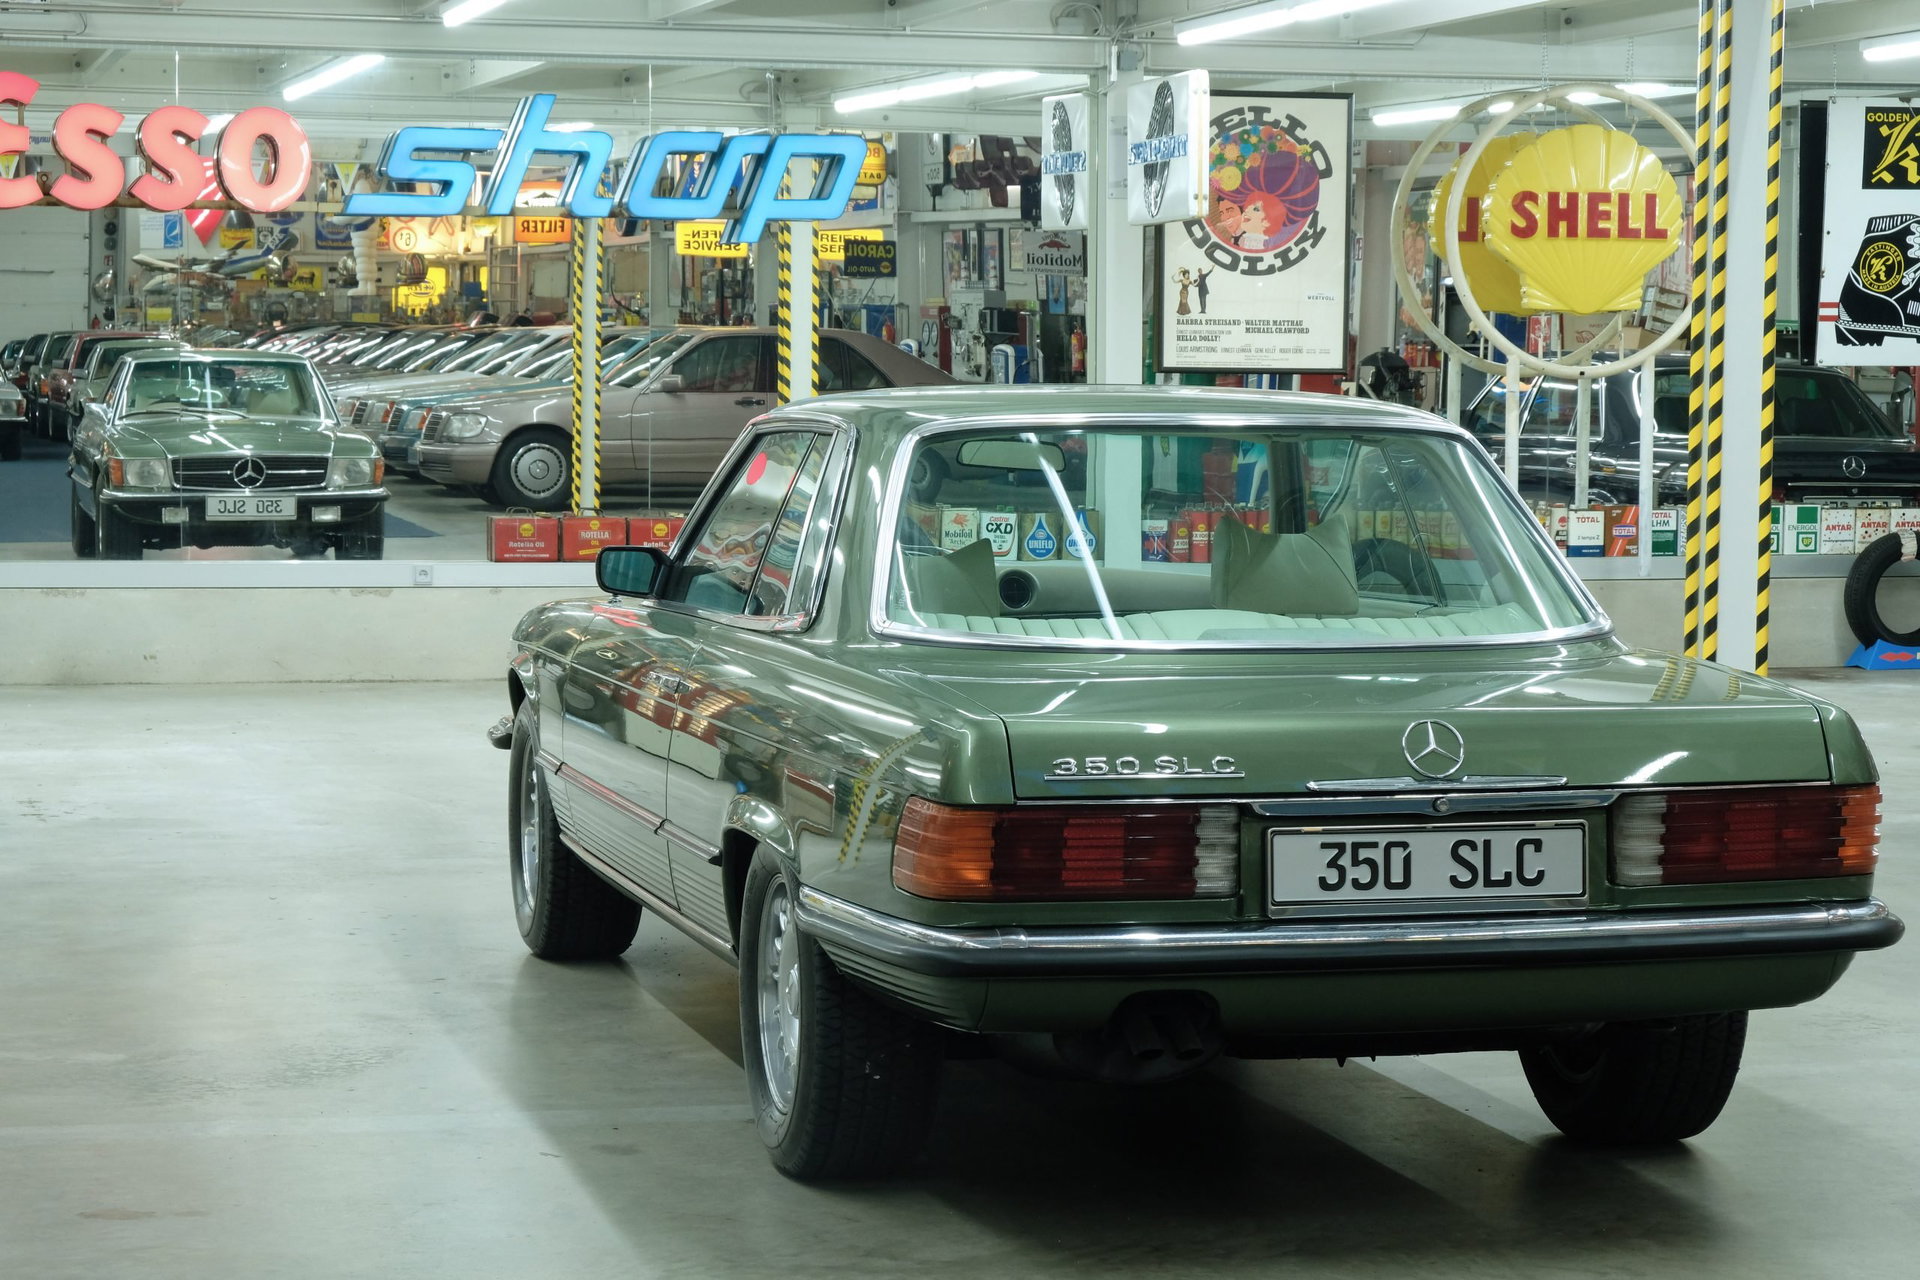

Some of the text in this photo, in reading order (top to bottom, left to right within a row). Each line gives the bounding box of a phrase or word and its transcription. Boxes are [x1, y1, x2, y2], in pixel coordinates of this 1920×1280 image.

[1866, 112, 1910, 123] GOLDEN
[1209, 105, 1333, 179] ELLO
[341, 93, 868, 244] shop
[1510, 190, 1668, 239] SHELL
[1866, 244, 1902, 262] KASTINGER
[1879, 274, 1901, 290] AUSTRIA
[1176, 318, 1204, 326] BARBRA
[1204, 318, 1241, 326] STREISAND
[1272, 319, 1304, 327] MATTHAU
[1245, 326, 1274, 334] MICHAEL
[986, 523, 1013, 534] CXD
[1652, 519, 1670, 527] LHM
[1861, 521, 1887, 529] ANTAR
[580, 531, 609, 539] ROTELLA
[944, 528, 973, 539] Mobiloil
[1029, 540, 1053, 549] UNIFLO
[1052, 756, 1236, 775] 350 SLC
[1318, 837, 1545, 892] 350 SLC
